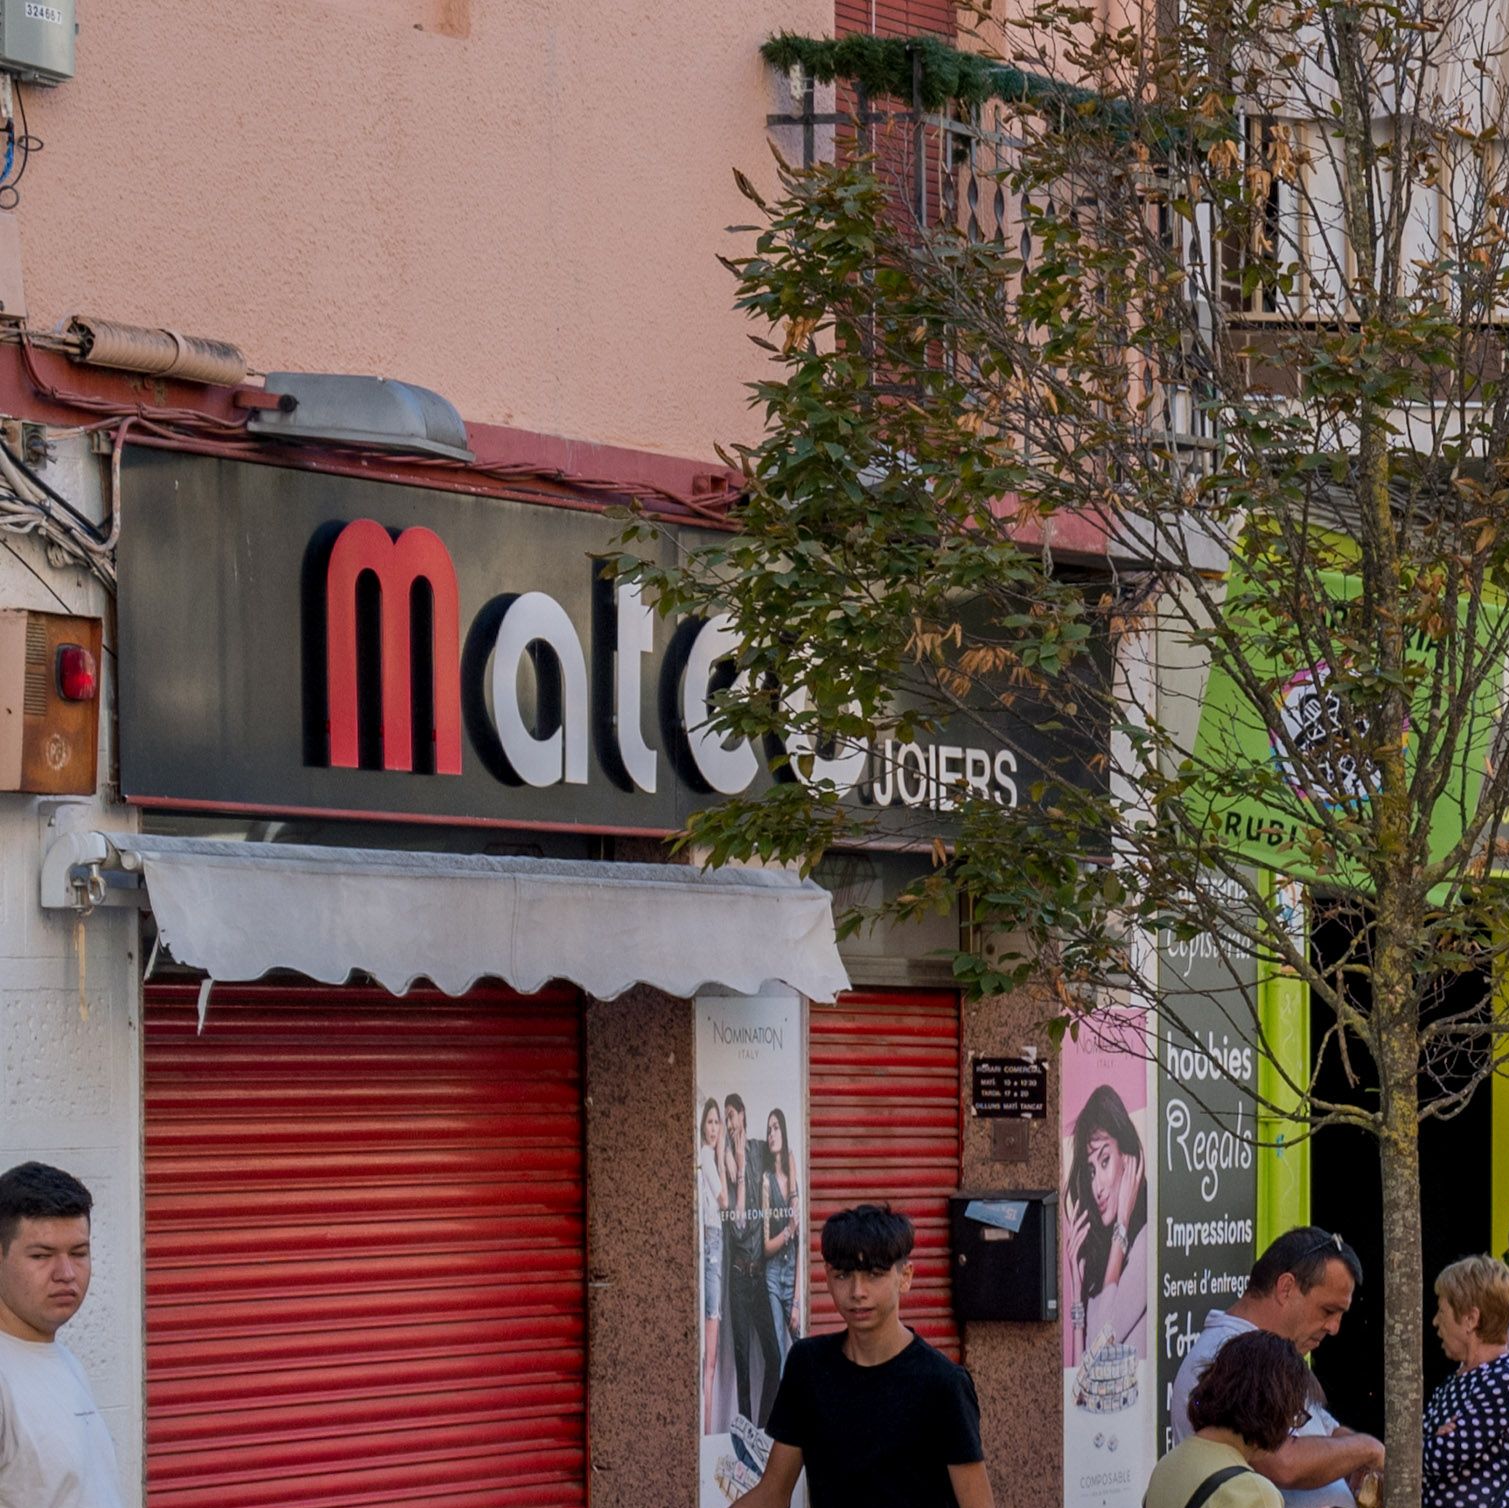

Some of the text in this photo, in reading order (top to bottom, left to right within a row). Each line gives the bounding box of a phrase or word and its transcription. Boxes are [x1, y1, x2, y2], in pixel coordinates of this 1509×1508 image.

[713, 1019, 783, 1051] NOMINATION
[1167, 1031, 1252, 1080] hobbies
[1166, 1098, 1252, 1202] Regals
[1166, 1213, 1253, 1257] Impressions
[1163, 1272, 1198, 1298] Servei
